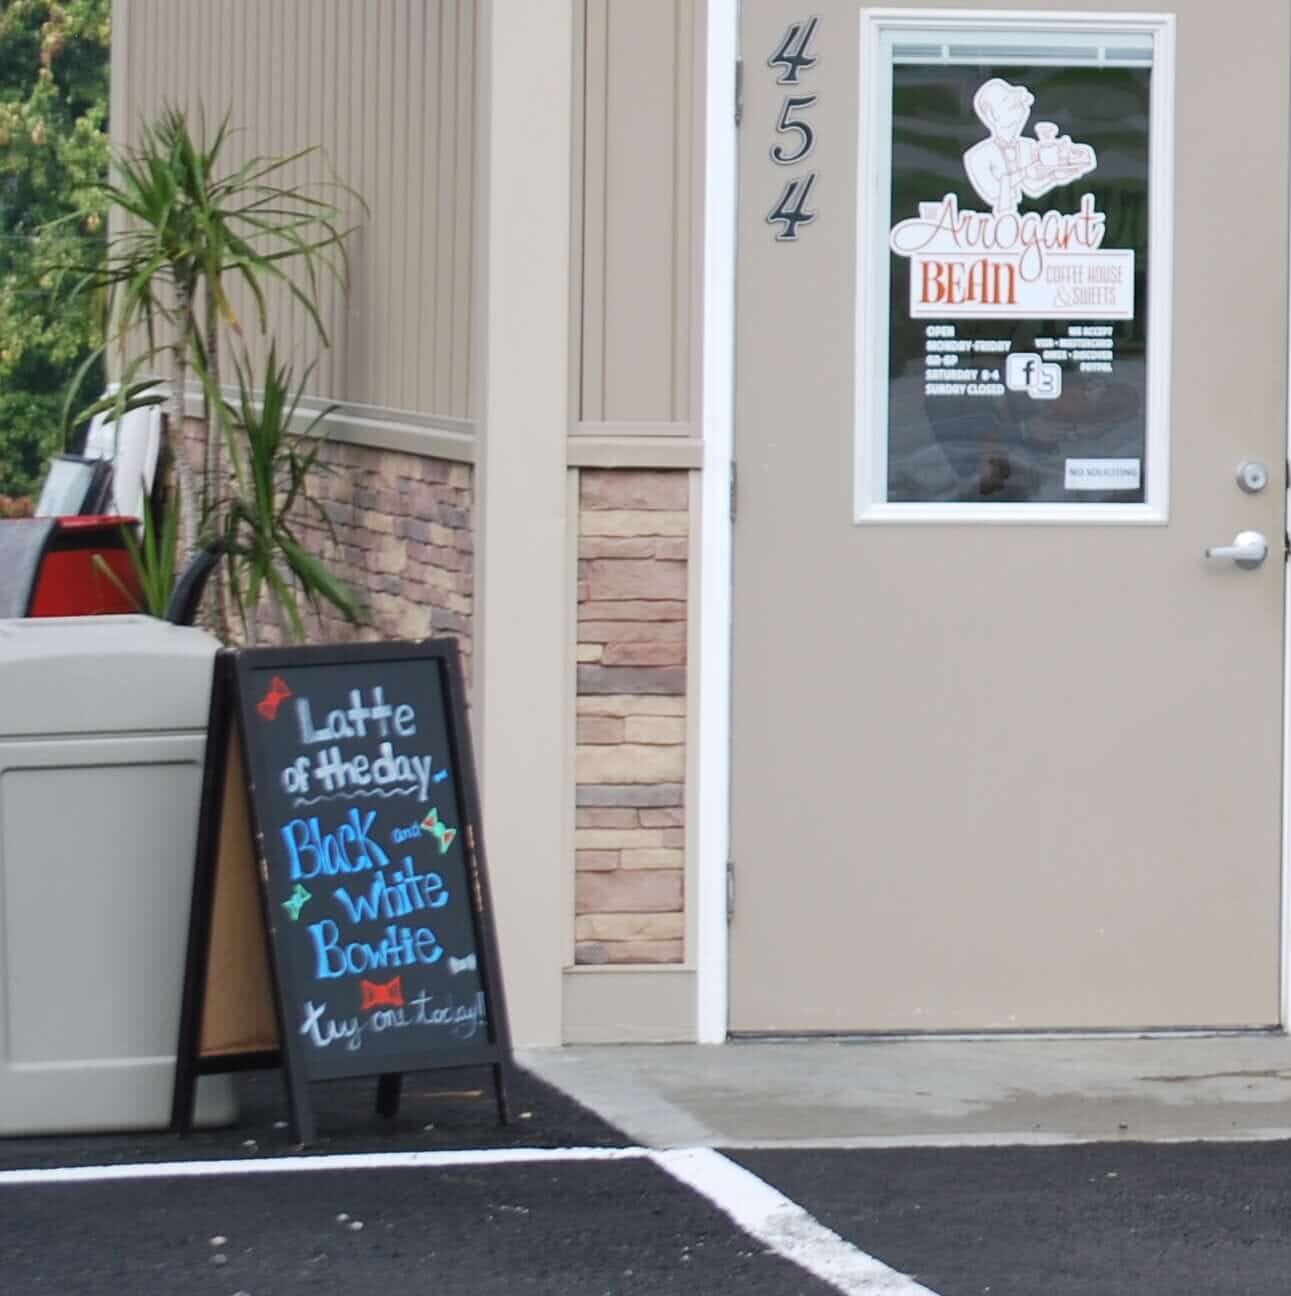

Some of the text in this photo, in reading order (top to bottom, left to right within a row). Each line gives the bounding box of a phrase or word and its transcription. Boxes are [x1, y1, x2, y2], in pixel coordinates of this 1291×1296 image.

[892, 196, 1101, 282] Arrogant
[919, 257, 1018, 305] BEAN
[1045, 264, 1124, 284] COFFEE HOUSE
[1073, 286, 1116, 305] SWEETS
[296, 686, 417, 745] Latte
[283, 755, 311, 794] of
[280, 807, 423, 881] Black and
